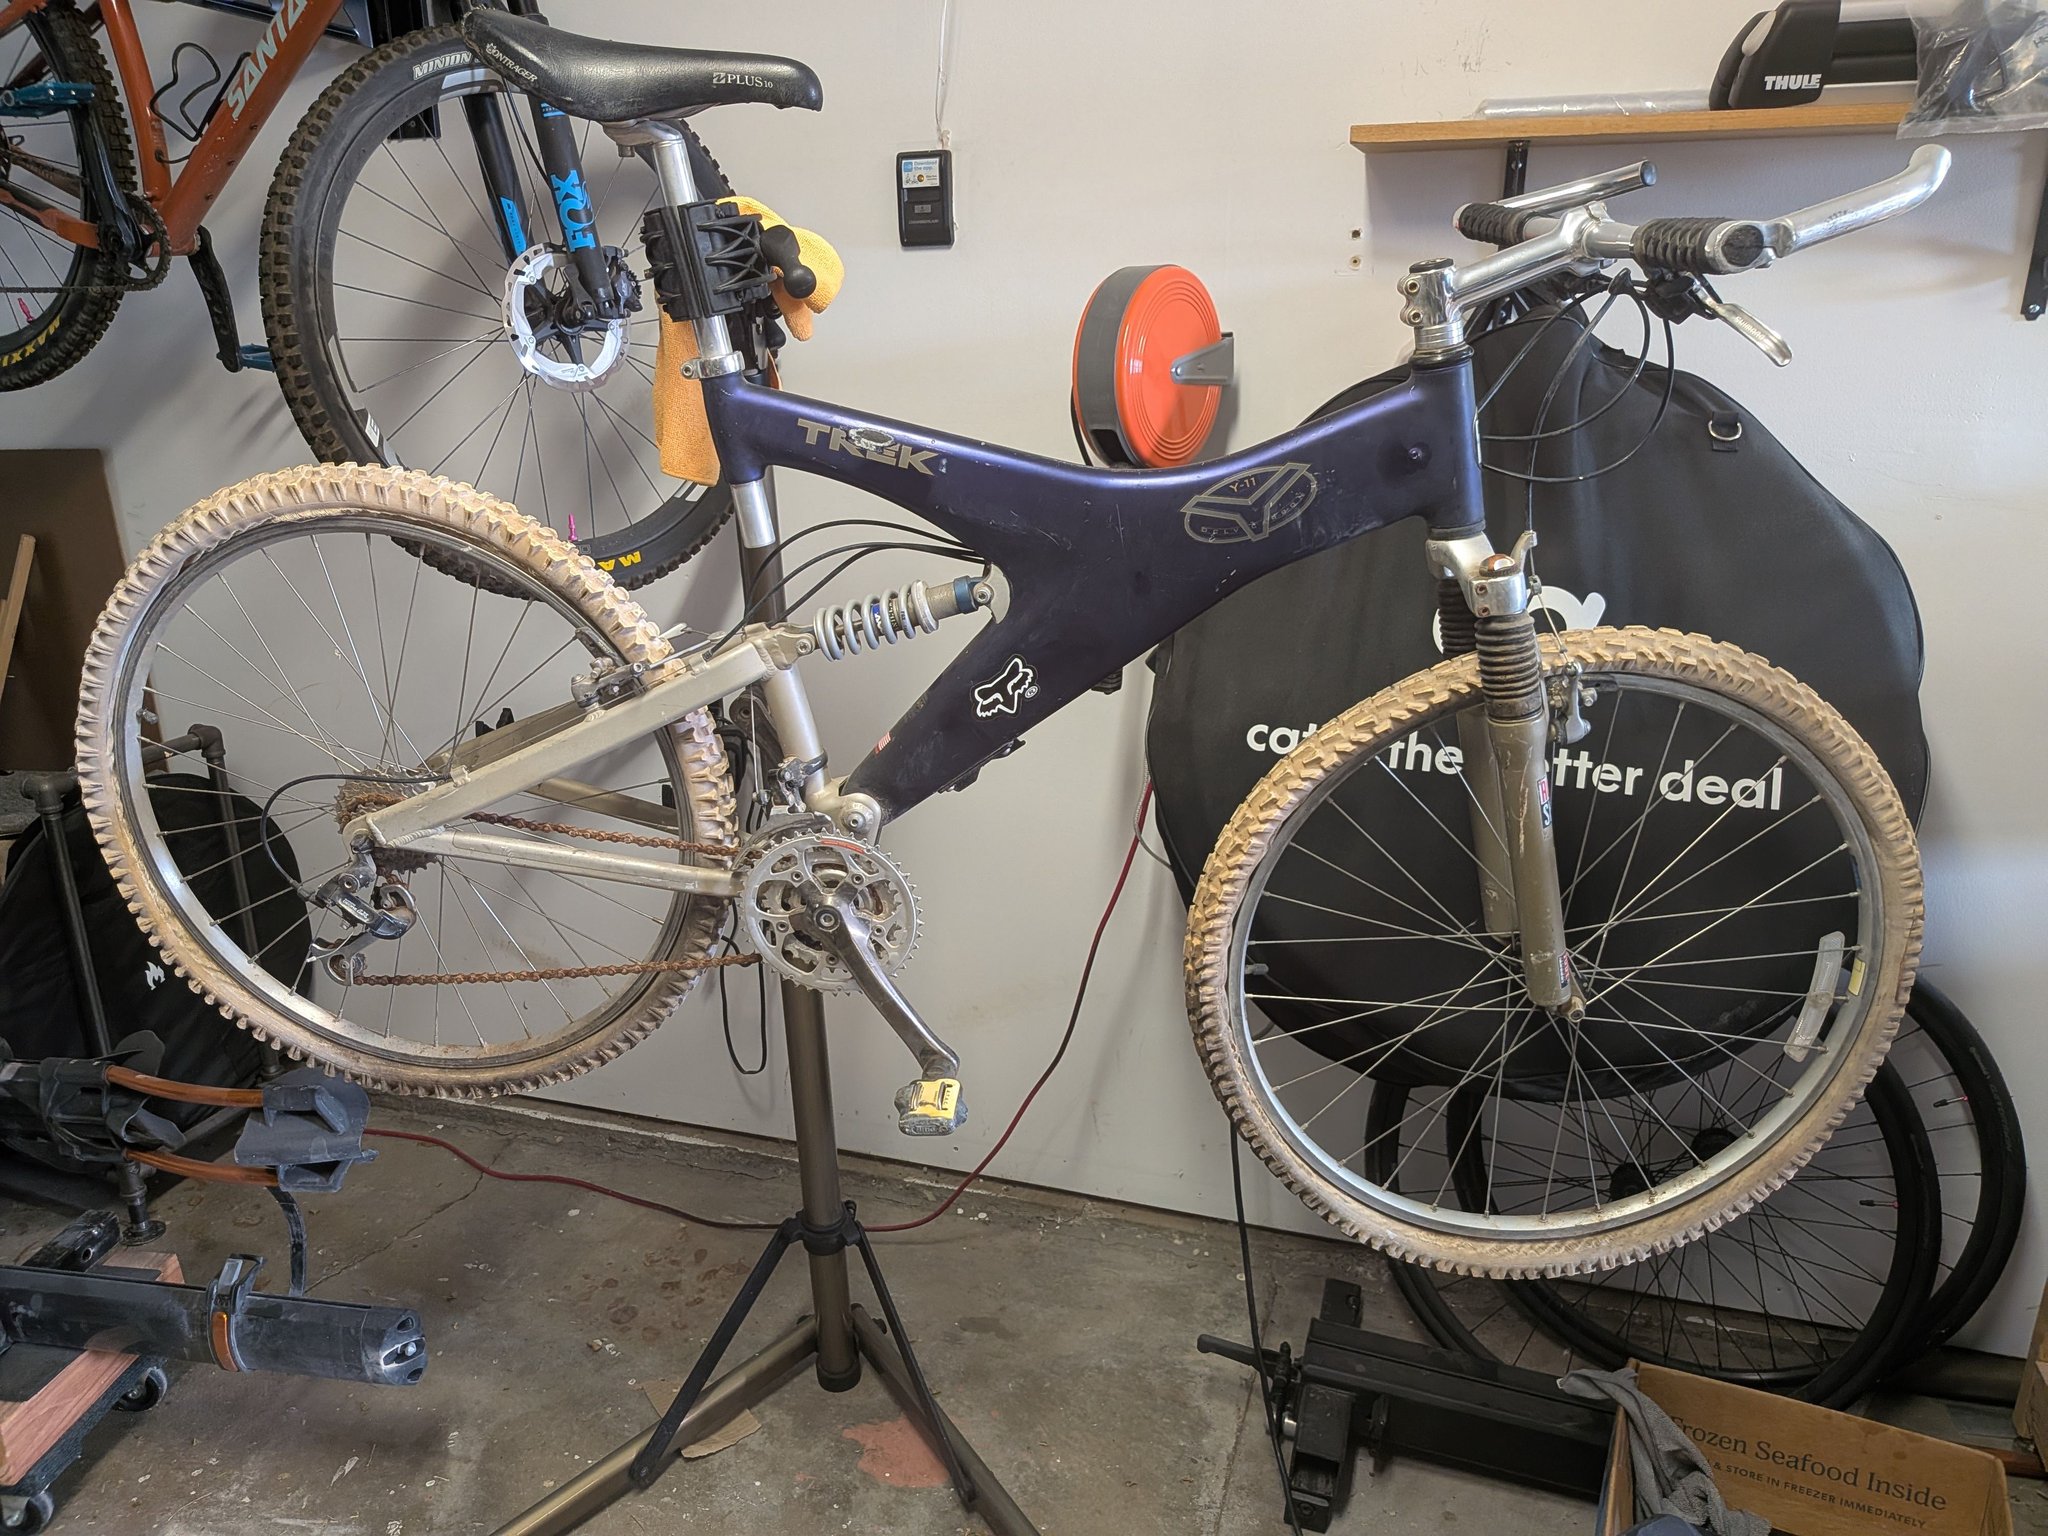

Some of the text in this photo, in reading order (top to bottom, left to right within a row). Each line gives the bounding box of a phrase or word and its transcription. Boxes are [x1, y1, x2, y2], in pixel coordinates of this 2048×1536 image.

[227, 0, 307, 120] SANTA
[413, 51, 472, 80] MINION
[1764, 74, 1822, 91] THULE
[550, 169, 595, 252] FOX
[0, 313, 62, 368] MAXXI
[797, 417, 940, 476] TREK
[1228, 476, 1257, 493] Y-11
[1388, 730, 1465, 775] the
[1546, 747, 1644, 796] tter
[1659, 759, 1783, 811] deal
[1726, 1464, 1764, 1483] STORE
[1767, 1475, 1780, 1488] IN
[1784, 1481, 1836, 1505] FREEZER
[1840, 1497, 1927, 1529] IMMEDIATELY
[1755, 1440, 1859, 1488] Seafood
[1867, 1471, 1947, 1511] Inside
